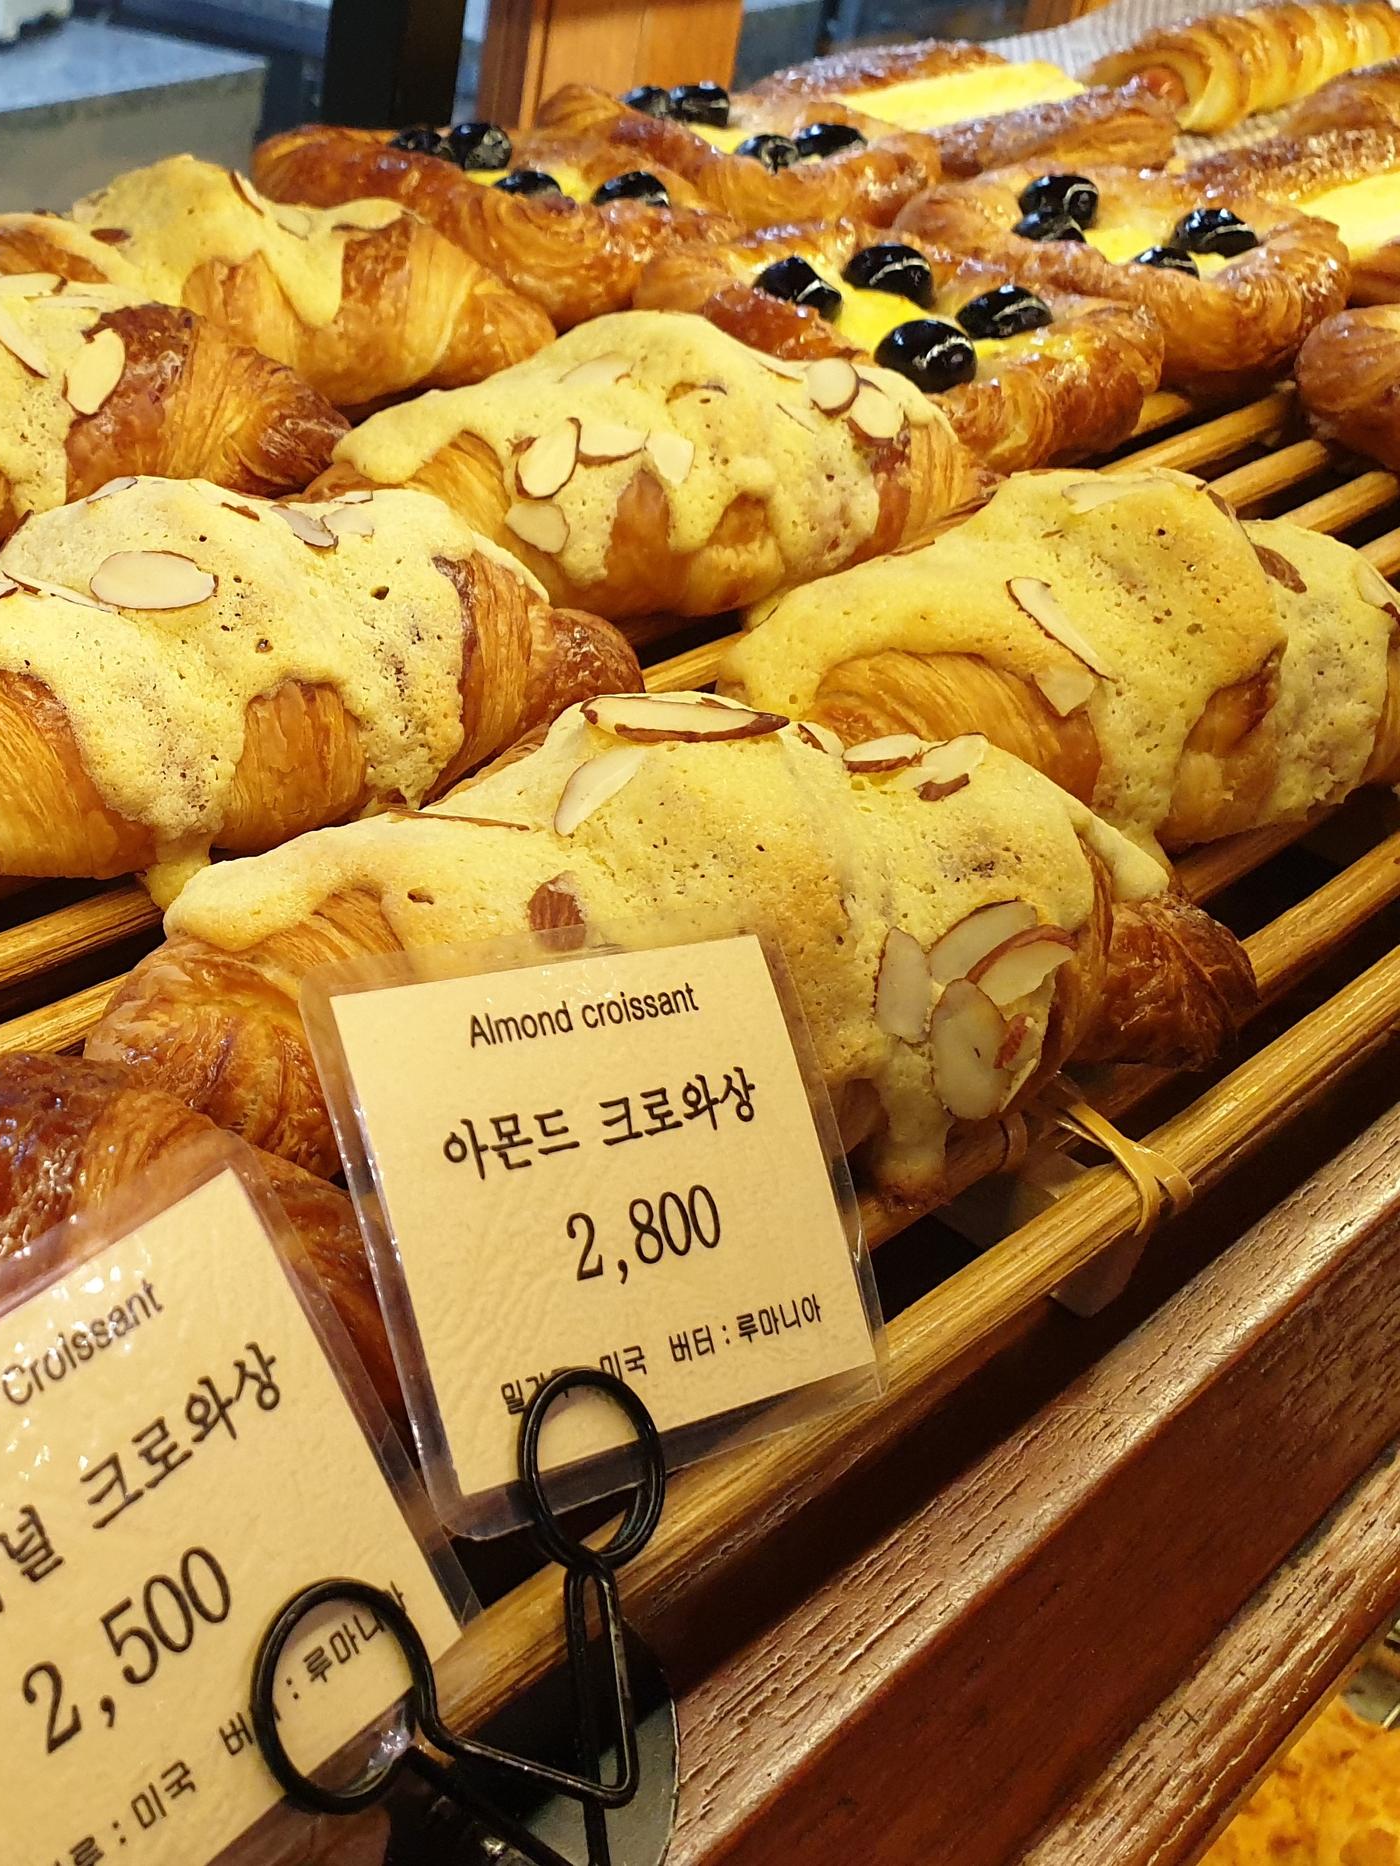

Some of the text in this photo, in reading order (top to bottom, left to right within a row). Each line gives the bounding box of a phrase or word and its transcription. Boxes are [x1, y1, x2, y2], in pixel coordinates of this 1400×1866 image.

[470, 982, 700, 1049] Almond croissant
[443, 1065, 756, 1181] 아몬드 크로와상
[566, 1184, 721, 1285] 2,800
[1, 1278, 164, 1406] Croissant
[599, 1345, 648, 1382] 미국
[736, 1293, 822, 1343] 루마니아
[79, 1341, 281, 1531] 크로와상
[21, 1545, 232, 1754] 2,500
[130, 1759, 197, 1830] 미국
